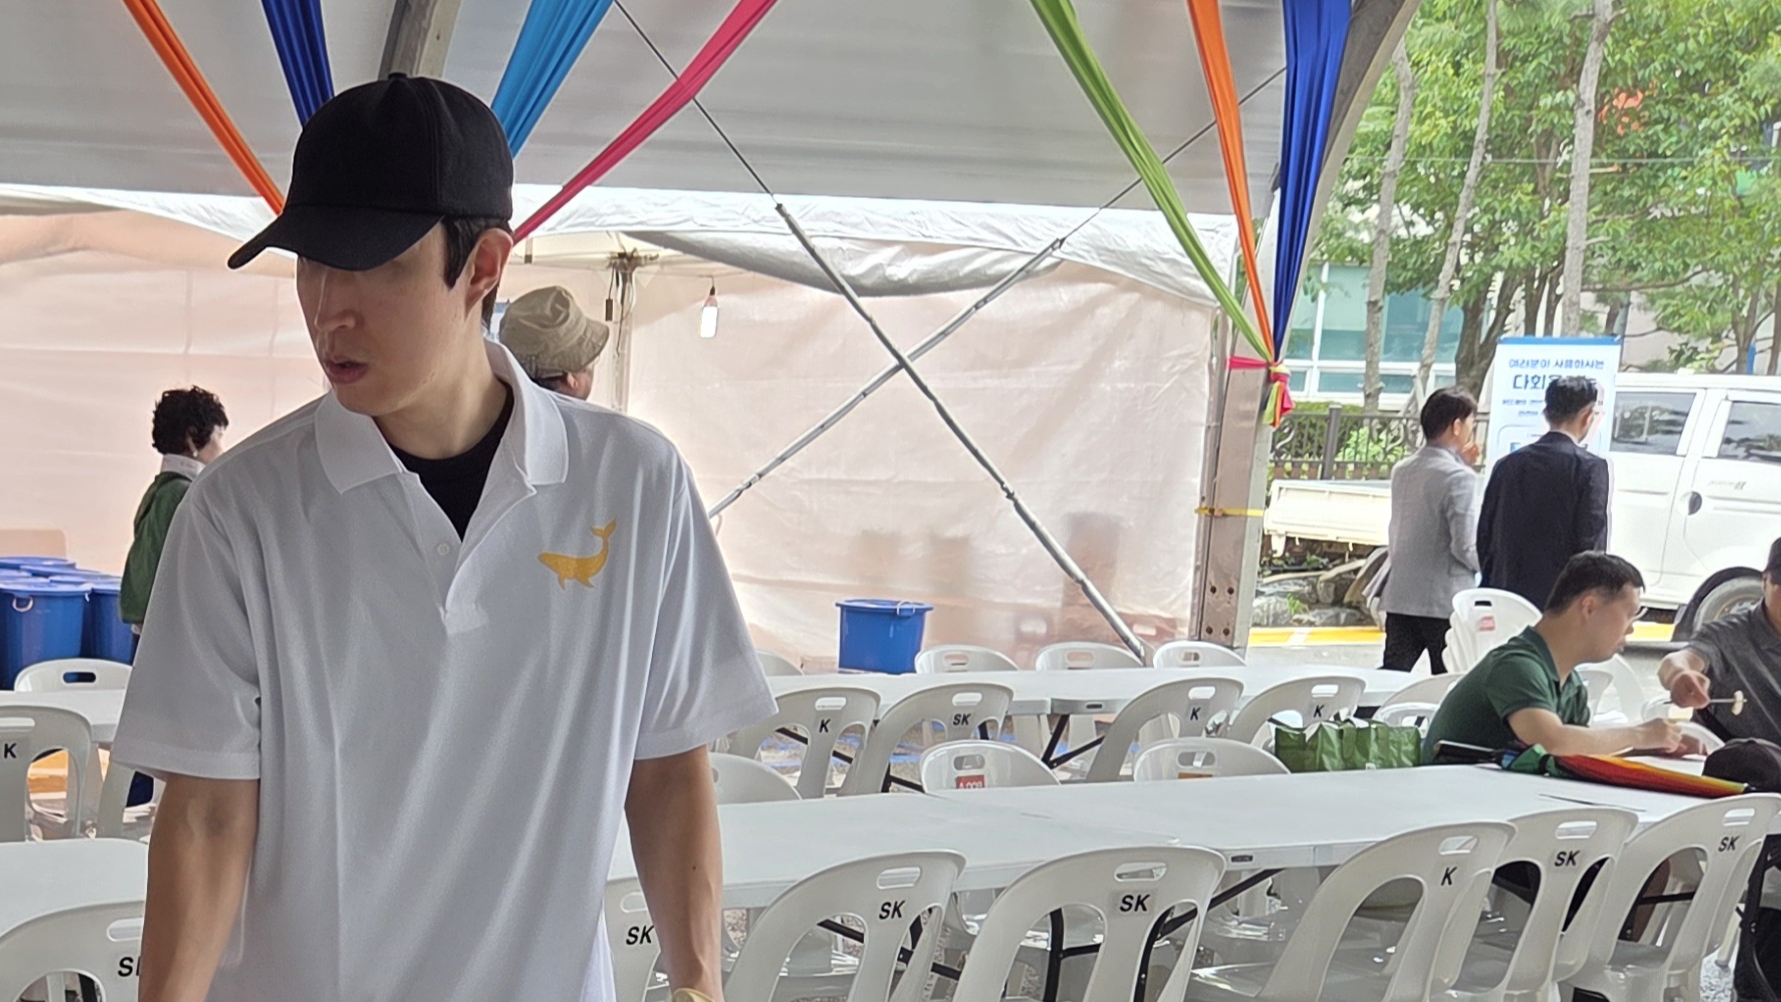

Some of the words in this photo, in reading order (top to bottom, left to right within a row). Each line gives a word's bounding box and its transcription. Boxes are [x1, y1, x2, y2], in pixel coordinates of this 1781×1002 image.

[1191, 707, 1201, 720] K
[1314, 705, 1324, 718] K
[819, 719, 830, 734] K
[952, 713, 972, 728] SK
[3, 743, 17, 759] K
[1718, 836, 1738, 852] SK
[1554, 850, 1580, 867] SK
[1441, 867, 1457, 887] K
[879, 900, 906, 919] SK
[1120, 894, 1151, 913] SK
[625, 925, 655, 946] SK
[117, 956, 141, 978] S
